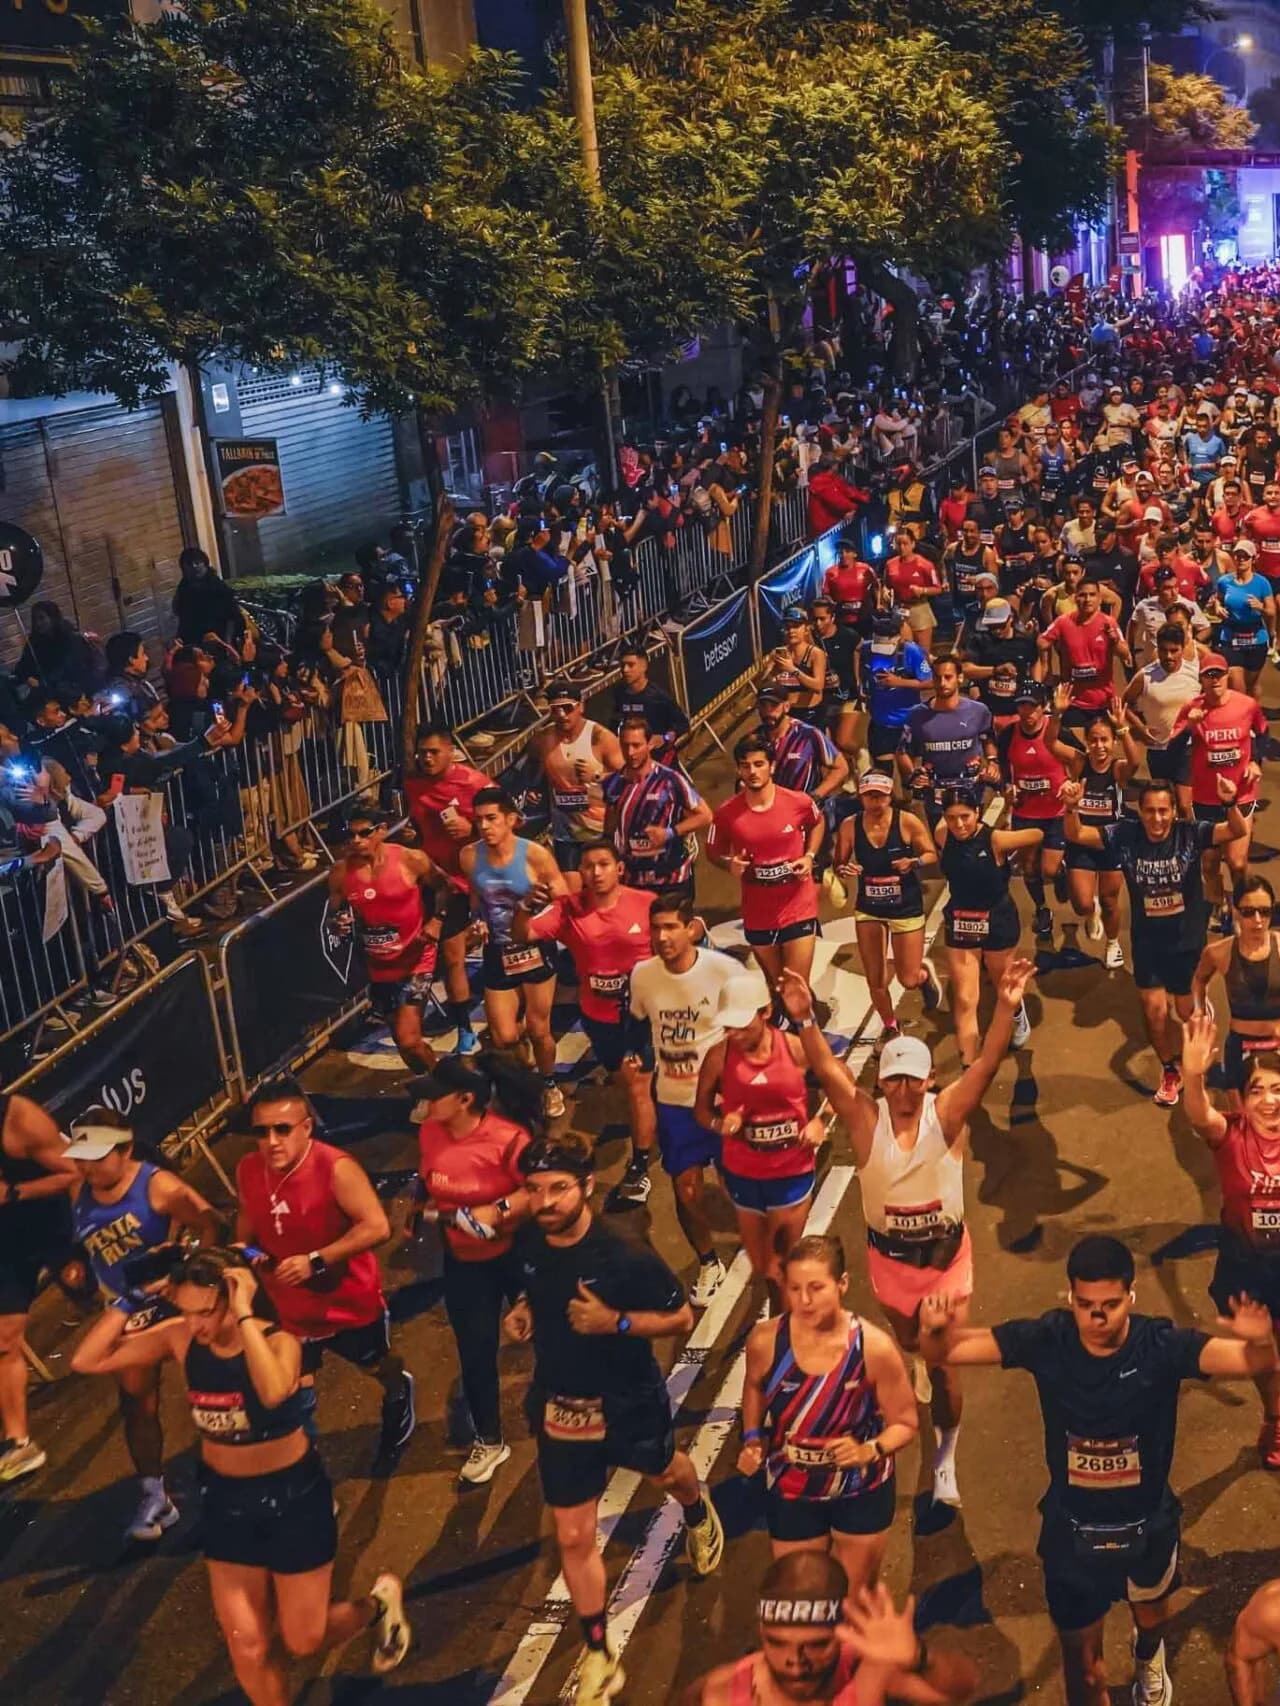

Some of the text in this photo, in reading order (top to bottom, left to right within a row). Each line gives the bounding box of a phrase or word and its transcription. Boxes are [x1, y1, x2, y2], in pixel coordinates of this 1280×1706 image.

[703, 632, 738, 672] betsson
[1206, 728, 1240, 742] PERU
[952, 739, 973, 750] CREW
[659, 1005, 701, 1022] ready
[84, 1211, 142, 1256] PENTA
[1076, 1455, 1128, 1472] 2689
[760, 1598, 839, 1622] TERREX
